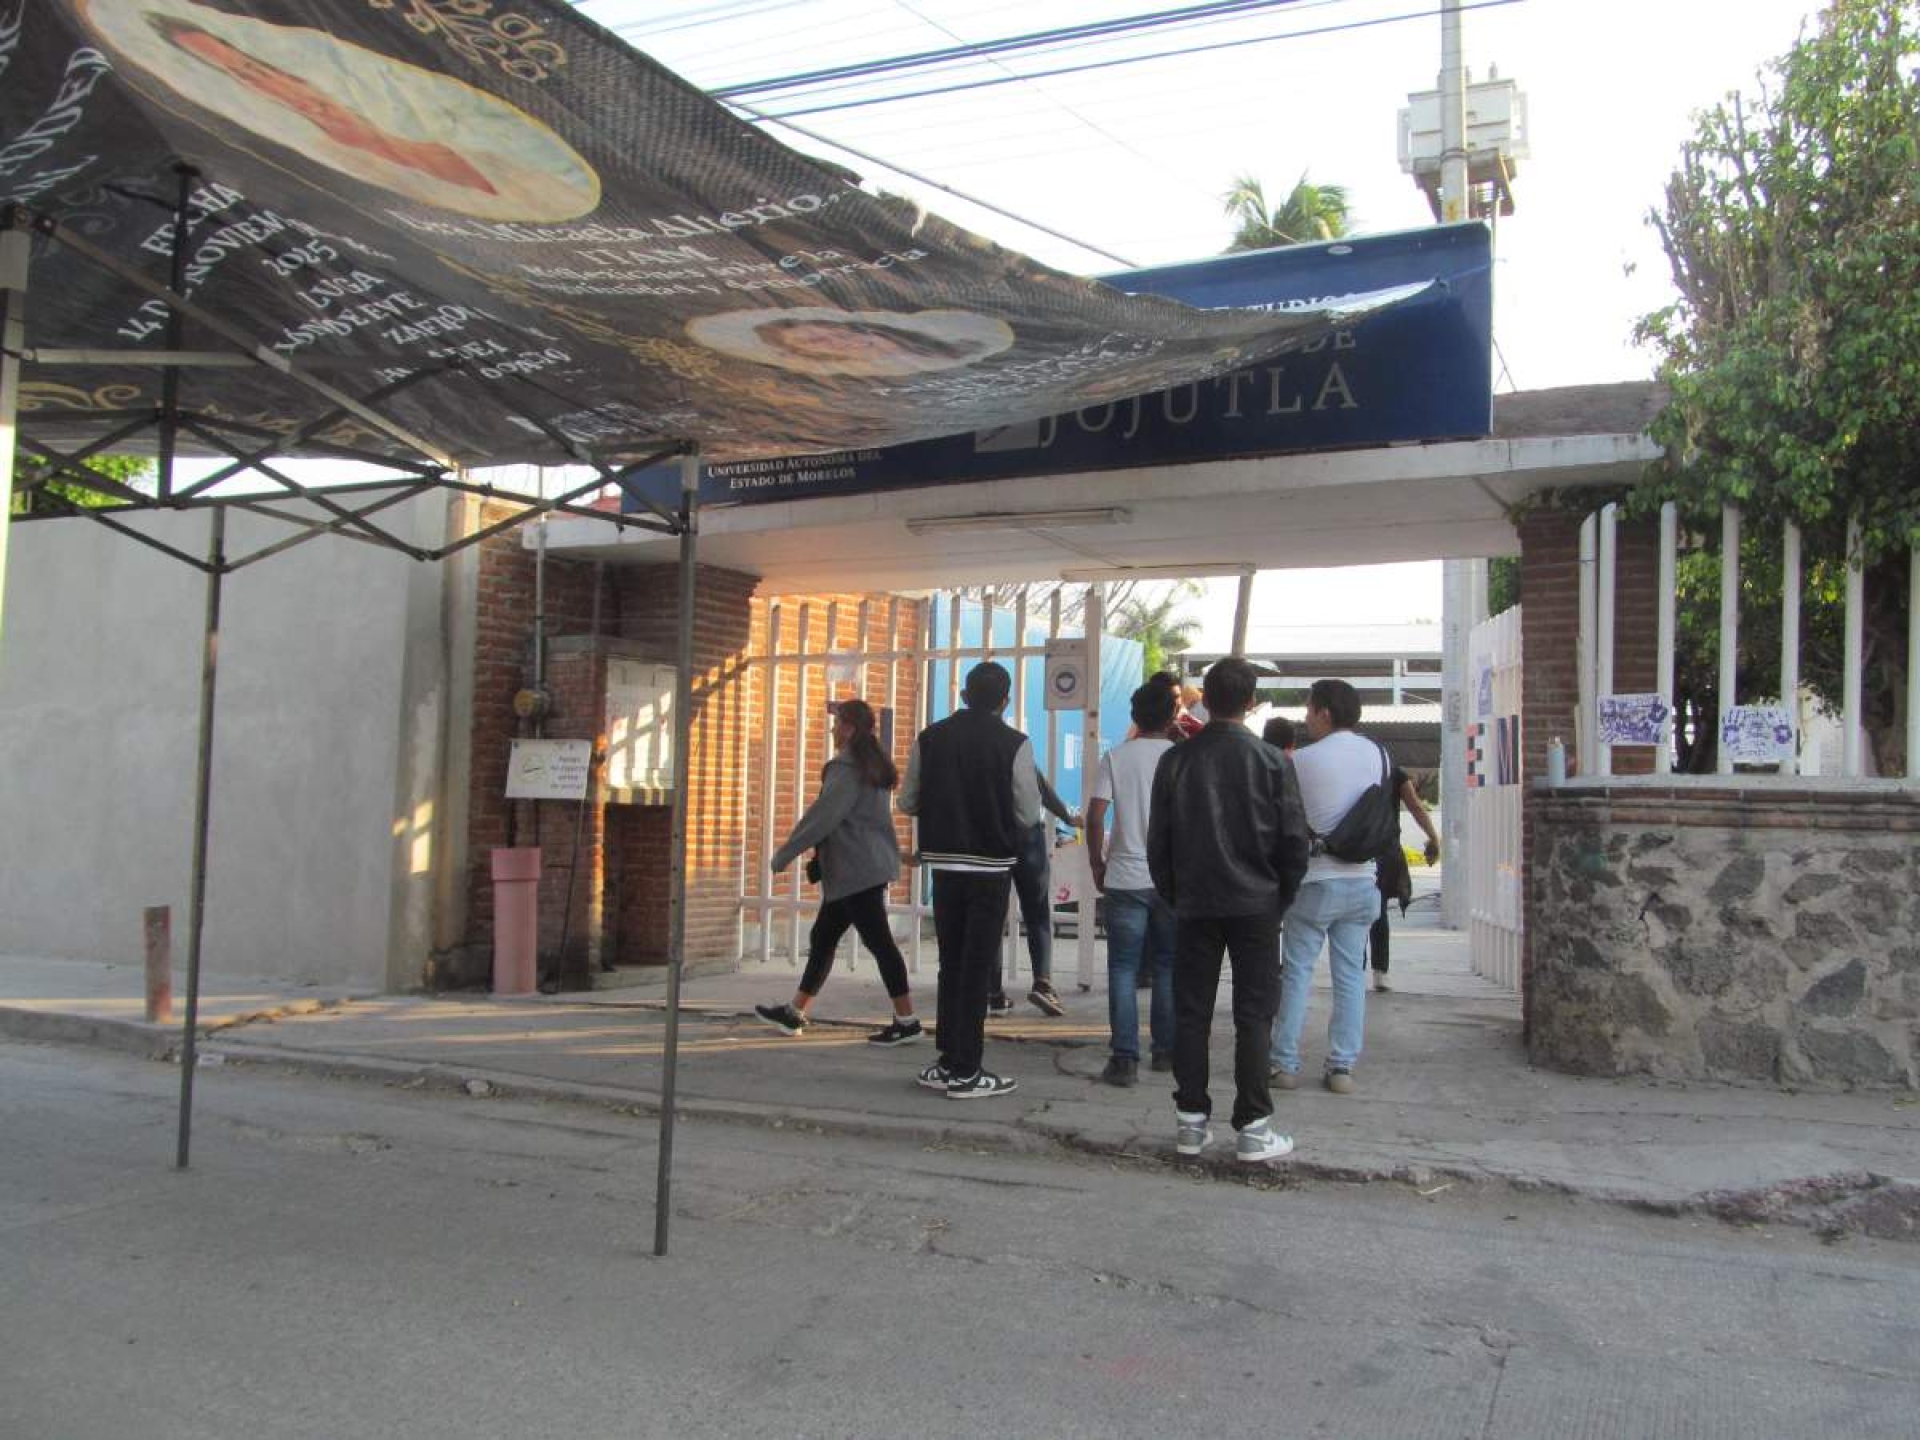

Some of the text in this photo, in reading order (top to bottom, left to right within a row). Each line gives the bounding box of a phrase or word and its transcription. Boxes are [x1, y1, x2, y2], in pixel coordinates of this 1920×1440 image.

[261, 239, 338, 277] 2025
[296, 270, 385, 308] LUGA
[1040, 362, 1359, 449] JOJUTLA
[708, 460, 784, 477] UNIVERSIDAD
[730, 466, 857, 489] ESTADO DE MORELOS
